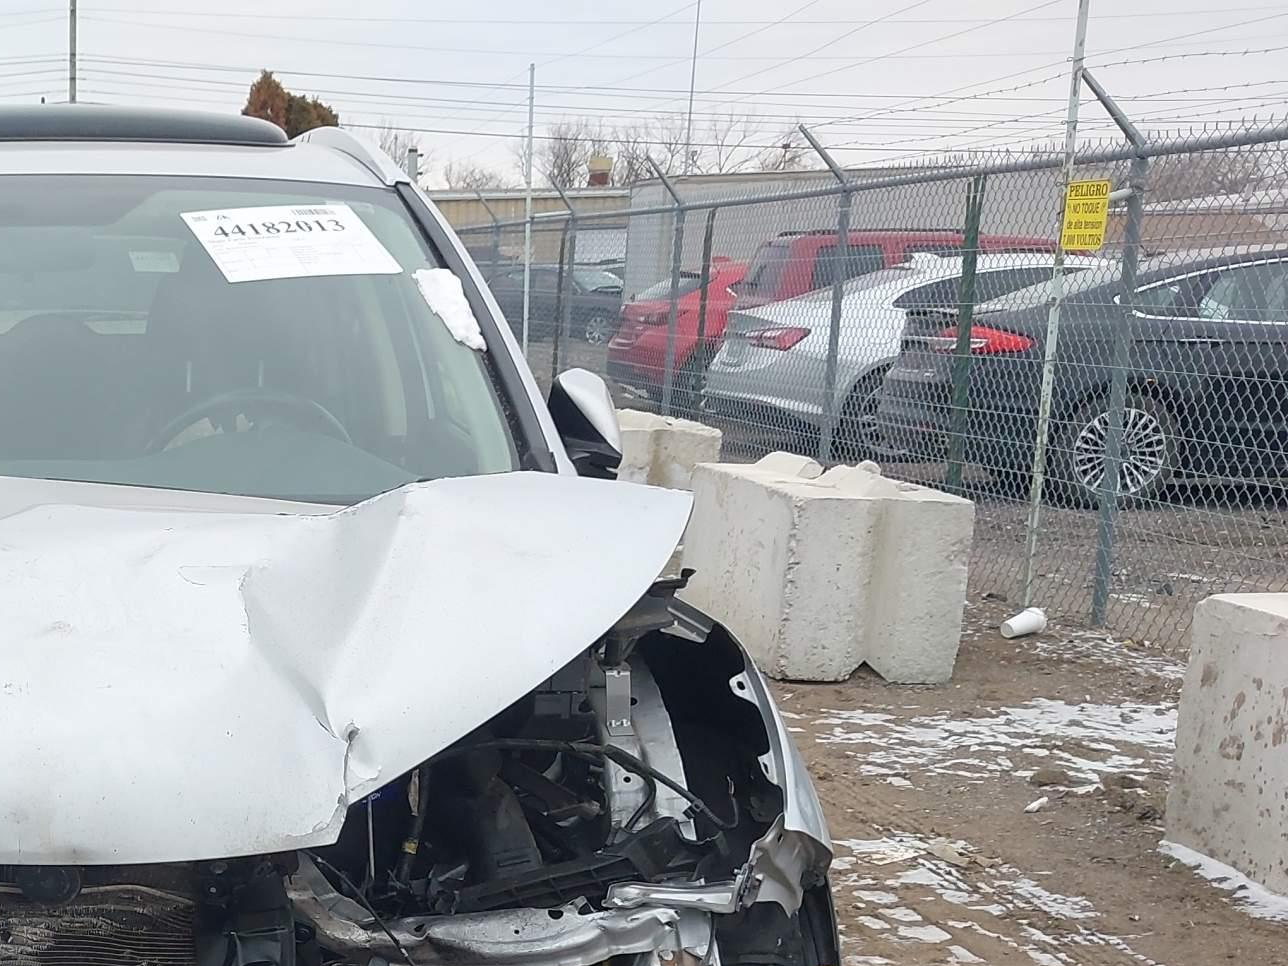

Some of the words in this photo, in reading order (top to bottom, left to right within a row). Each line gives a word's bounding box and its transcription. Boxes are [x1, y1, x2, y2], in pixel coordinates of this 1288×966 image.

[1069, 183, 1108, 197] PELIGRO
[1081, 202, 1101, 214] TOQUE
[214, 218, 346, 238] 44182013
[1076, 233, 1103, 246] VOLTIOS
